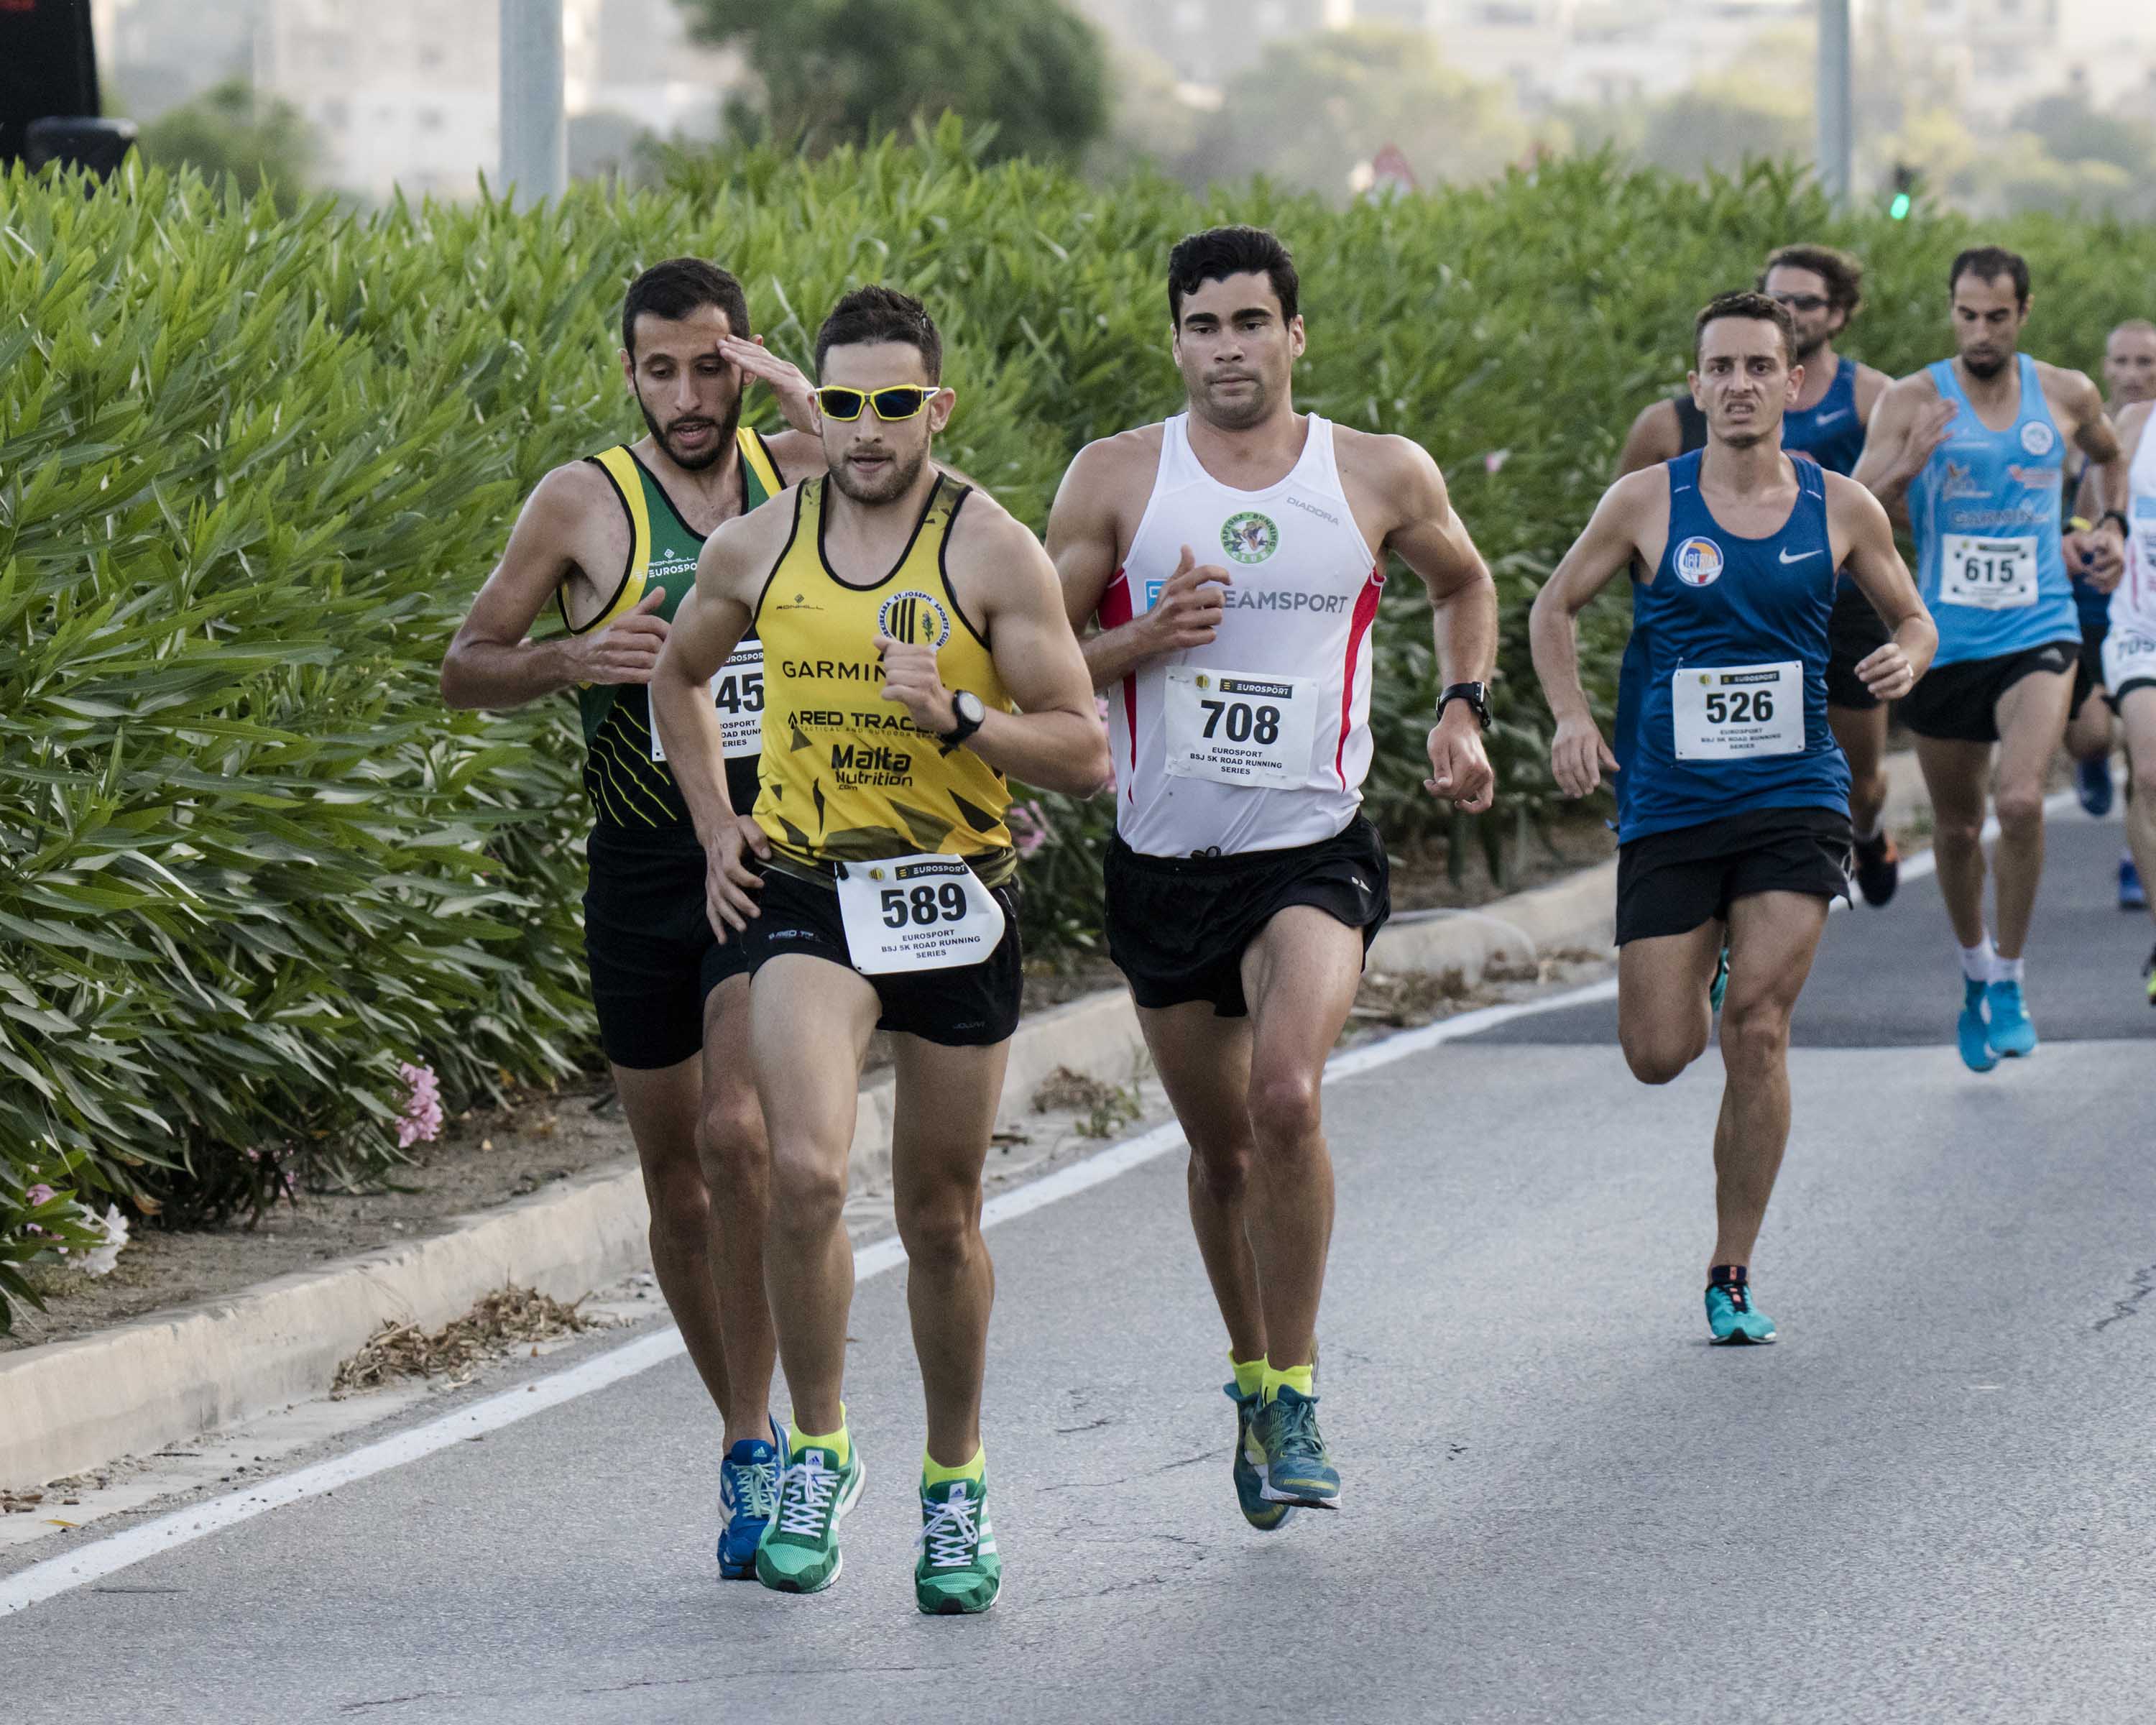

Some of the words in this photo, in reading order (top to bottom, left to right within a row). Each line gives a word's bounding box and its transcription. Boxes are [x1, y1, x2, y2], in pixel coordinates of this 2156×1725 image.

[1286, 497, 1339, 525] DIADORA
[648, 563, 697, 579] EUROSPO
[1964, 557, 2014, 583] 615
[1224, 589, 1348, 613] EAMSPORT
[714, 672, 765, 714] 45
[1236, 683, 1289, 696] EUROSPORT
[1706, 689, 1774, 724] 526
[720, 719, 756, 730] OSPORT
[800, 710, 844, 726] RED
[850, 712, 933, 734] TRAC
[1200, 699, 1281, 745] 708
[722, 739, 747, 748] ERIES
[831, 744, 912, 773] Malta
[1212, 747, 1263, 758] EUROSPORT
[1220, 757, 1243, 765] ROAD
[1245, 760, 1283, 770] RUNNING
[1221, 766, 1251, 776] SERIES
[835, 770, 913, 788] Nutrition
[913, 864, 966, 875] EUROSPORT
[880, 882, 967, 929] 589
[902, 929, 955, 942] EUROSPORT
[913, 941, 937, 950] ROAD
[939, 936, 981, 947] RUNNING
[916, 949, 947, 959] SERIES
